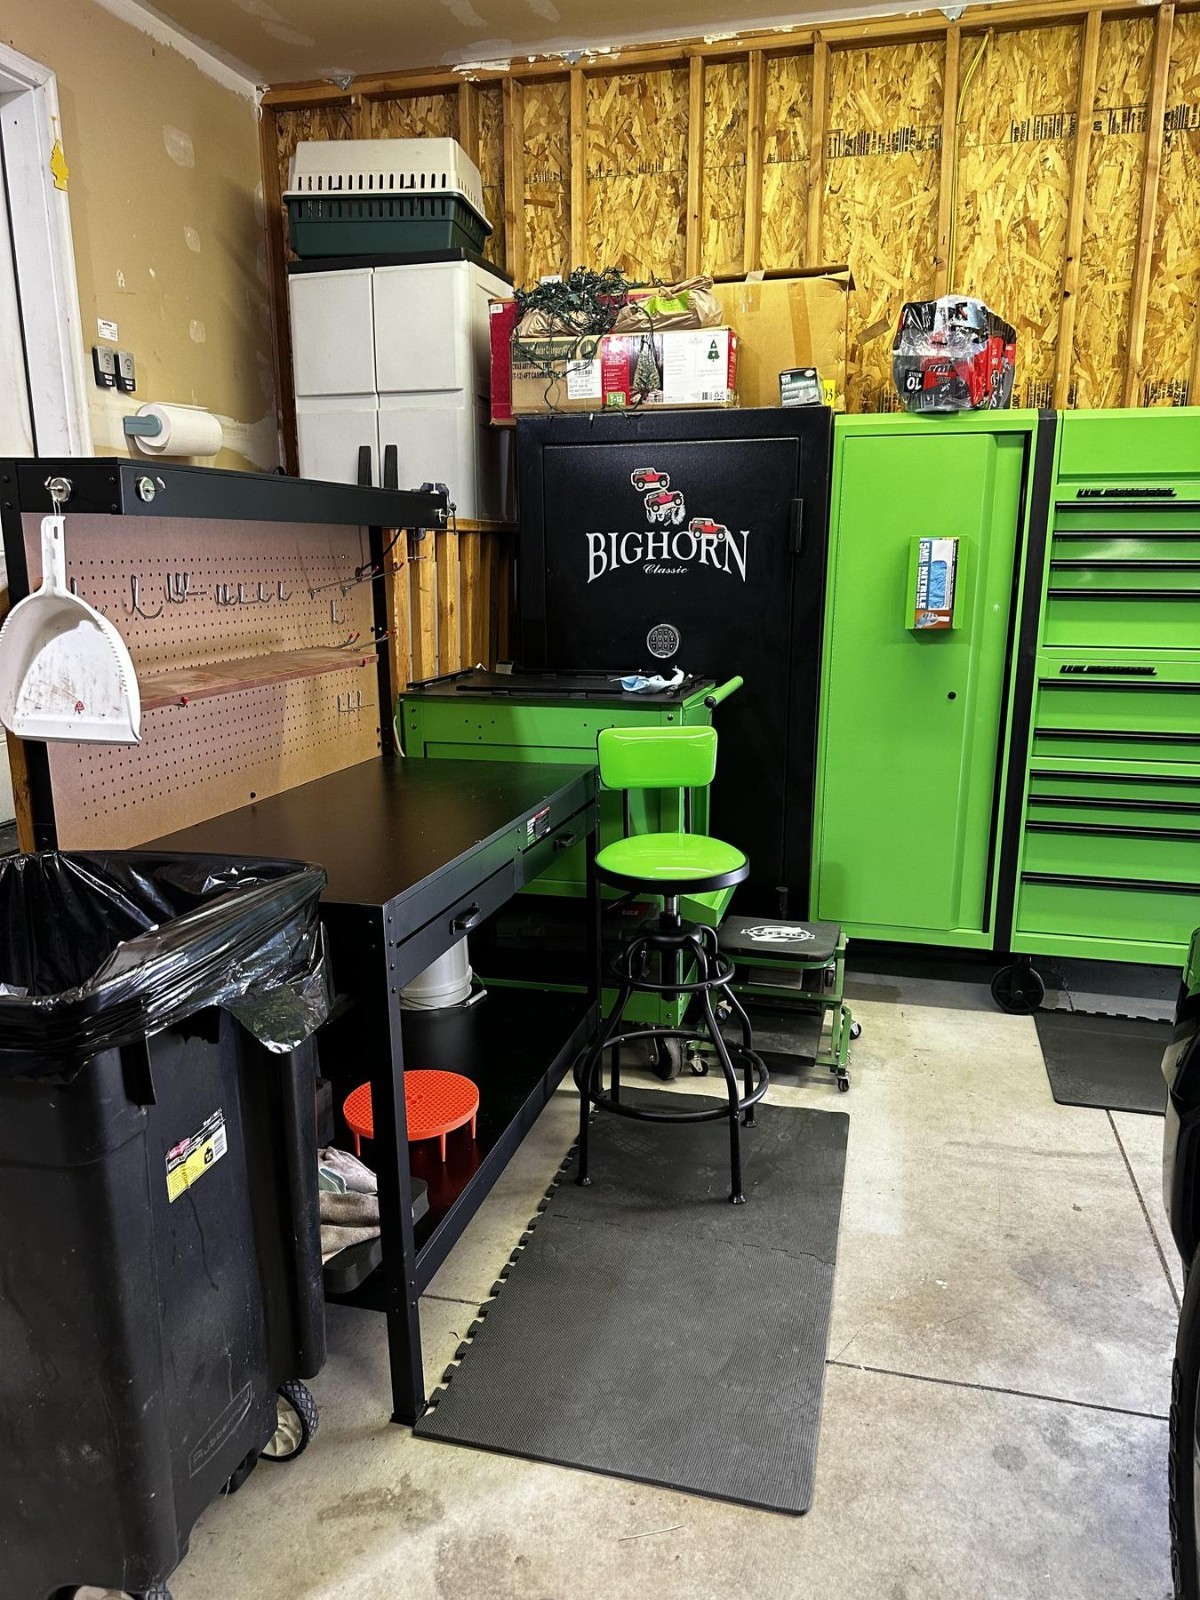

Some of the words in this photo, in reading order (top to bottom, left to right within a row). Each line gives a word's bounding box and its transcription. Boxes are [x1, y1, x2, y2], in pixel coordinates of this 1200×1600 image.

[585, 529, 751, 584] BIGHORN
[642, 563, 690, 575] Classic
[918, 566, 929, 609] NITRILE
